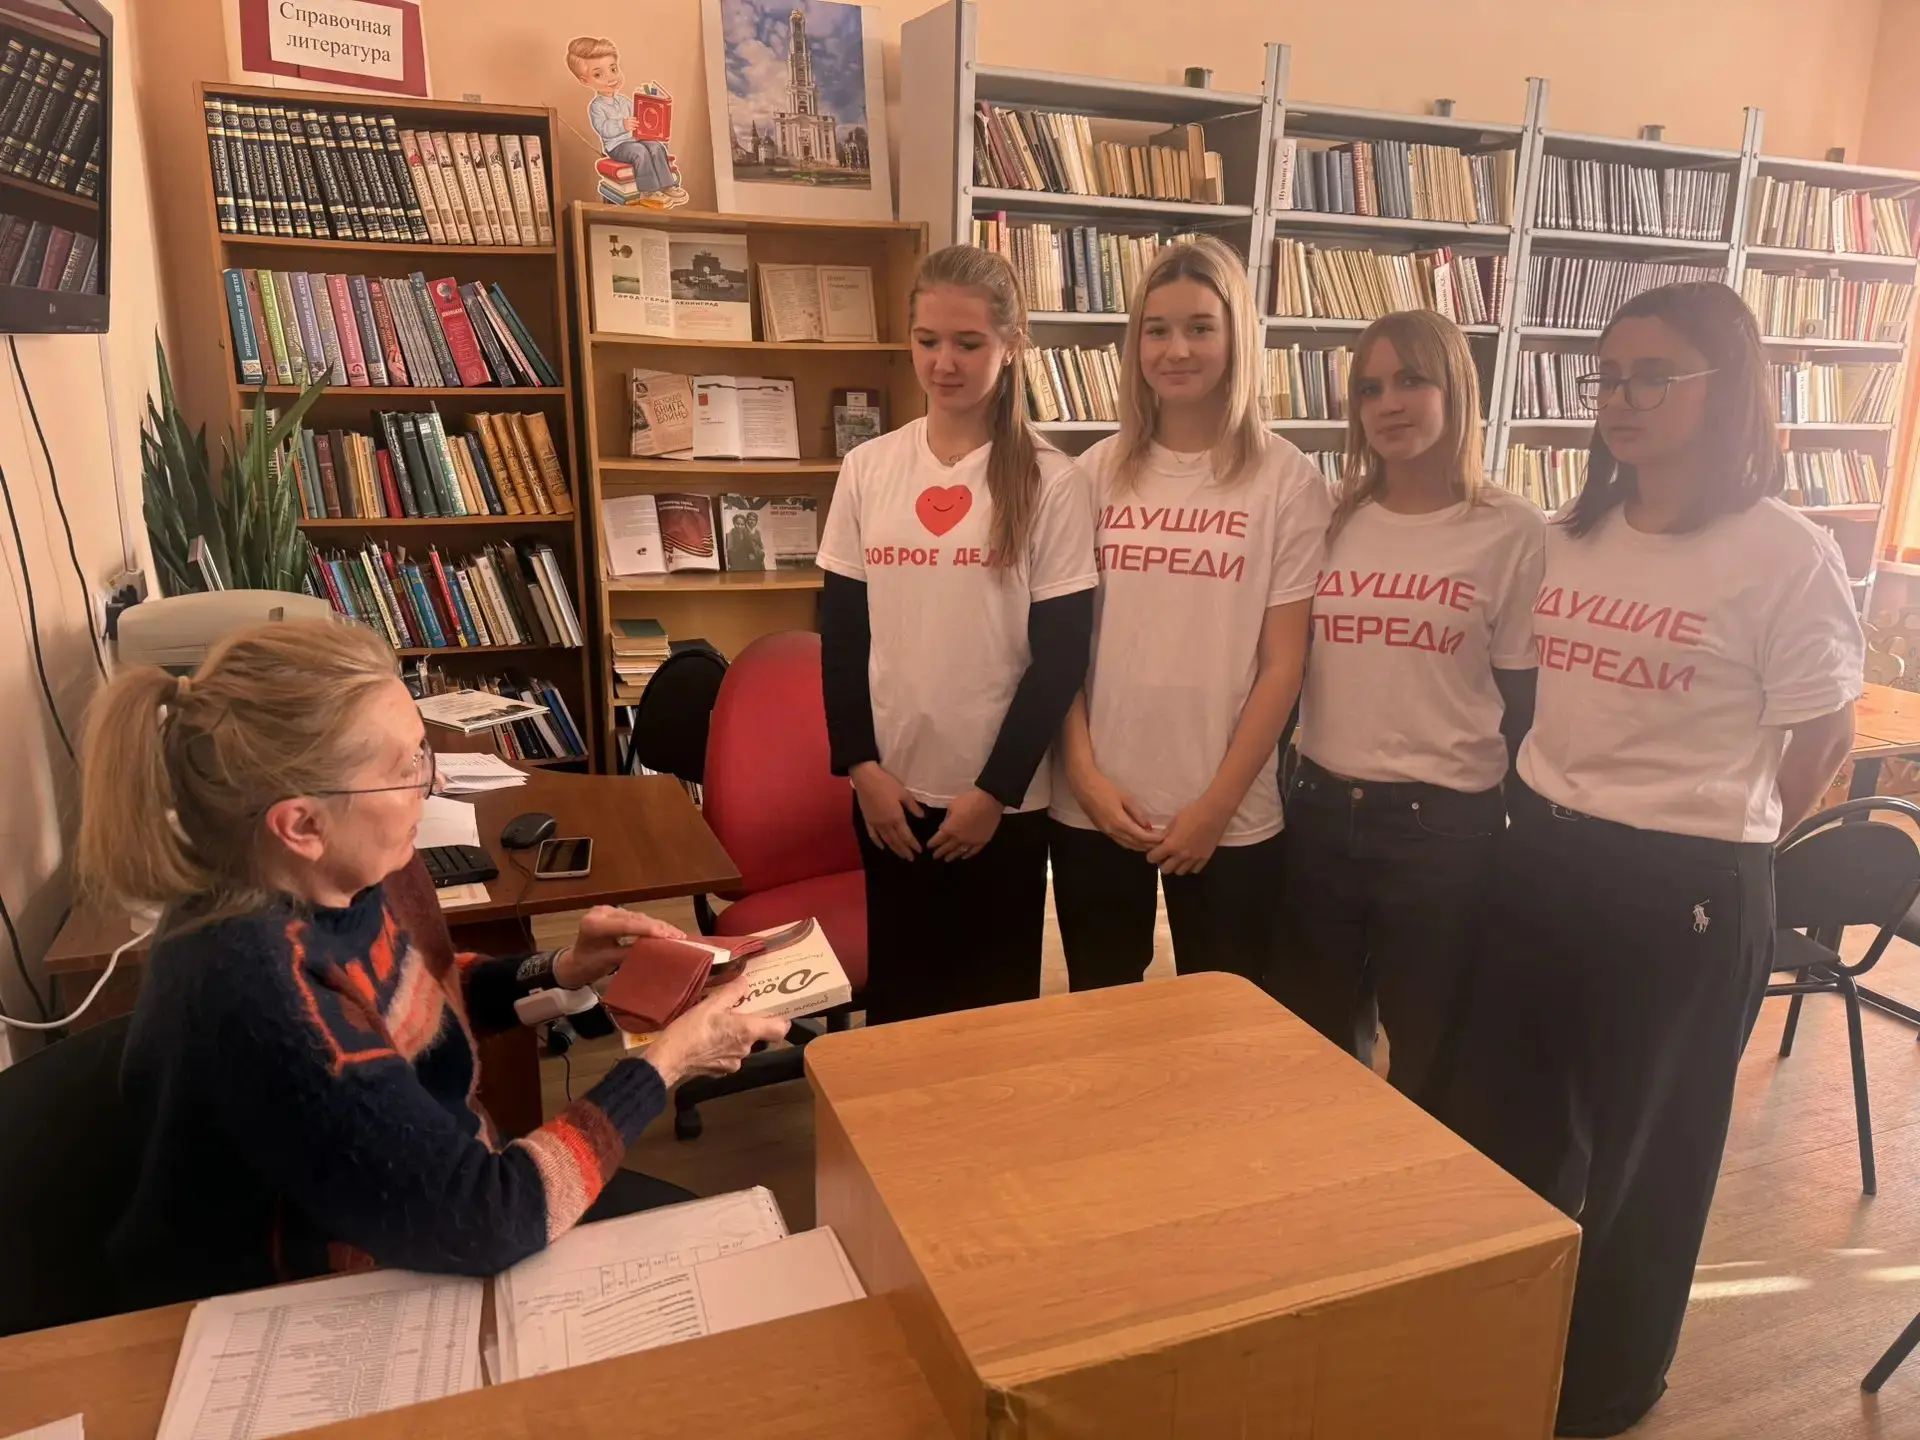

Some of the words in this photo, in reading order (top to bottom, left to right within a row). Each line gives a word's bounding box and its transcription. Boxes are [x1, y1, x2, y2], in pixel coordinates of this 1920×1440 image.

[280, 2, 391, 36] Справочная
[286, 34, 391, 64] литература
[952, 547, 1012, 567] ДЕЛ
[1312, 614, 1466, 656] ПЕРЕДИ
[1534, 586, 1706, 646] ДУЩИЕ
[1534, 634, 1696, 692] ПЕРЕДИ
